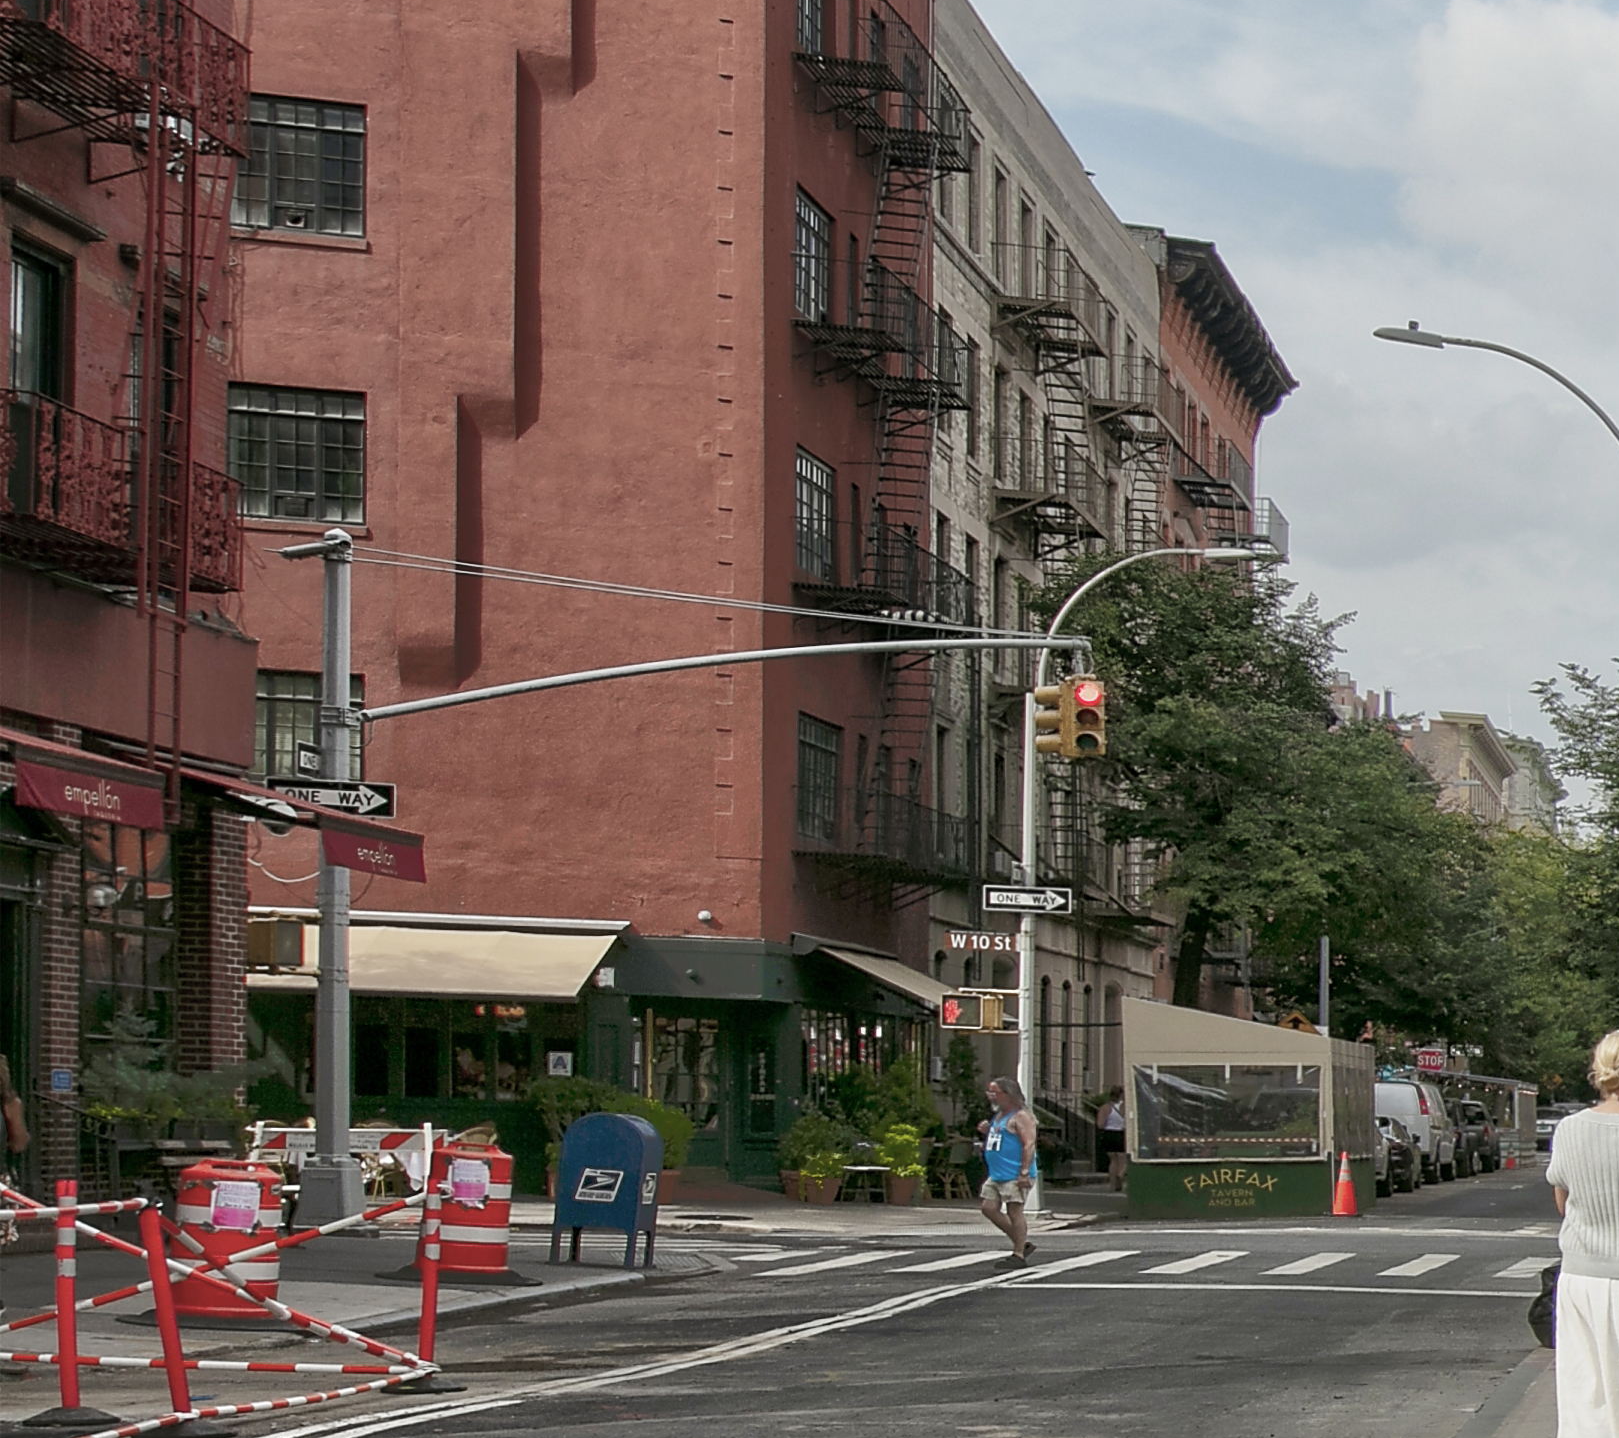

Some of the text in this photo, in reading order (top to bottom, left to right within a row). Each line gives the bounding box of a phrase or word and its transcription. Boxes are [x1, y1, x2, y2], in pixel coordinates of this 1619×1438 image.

[65, 779, 121, 815] empellón
[285, 789, 375, 806] ONE WAY
[997, 894, 1056, 905] ONE WAY
[950, 934, 1011, 950] W 10 St
[552, 1055, 567, 1069] A
[1417, 1055, 1443, 1066] STOP
[1183, 1169, 1278, 1193] FAIRFAX
[1211, 1189, 1253, 1197] TAVERN
[1208, 1198, 1255, 1207] AND BAR
